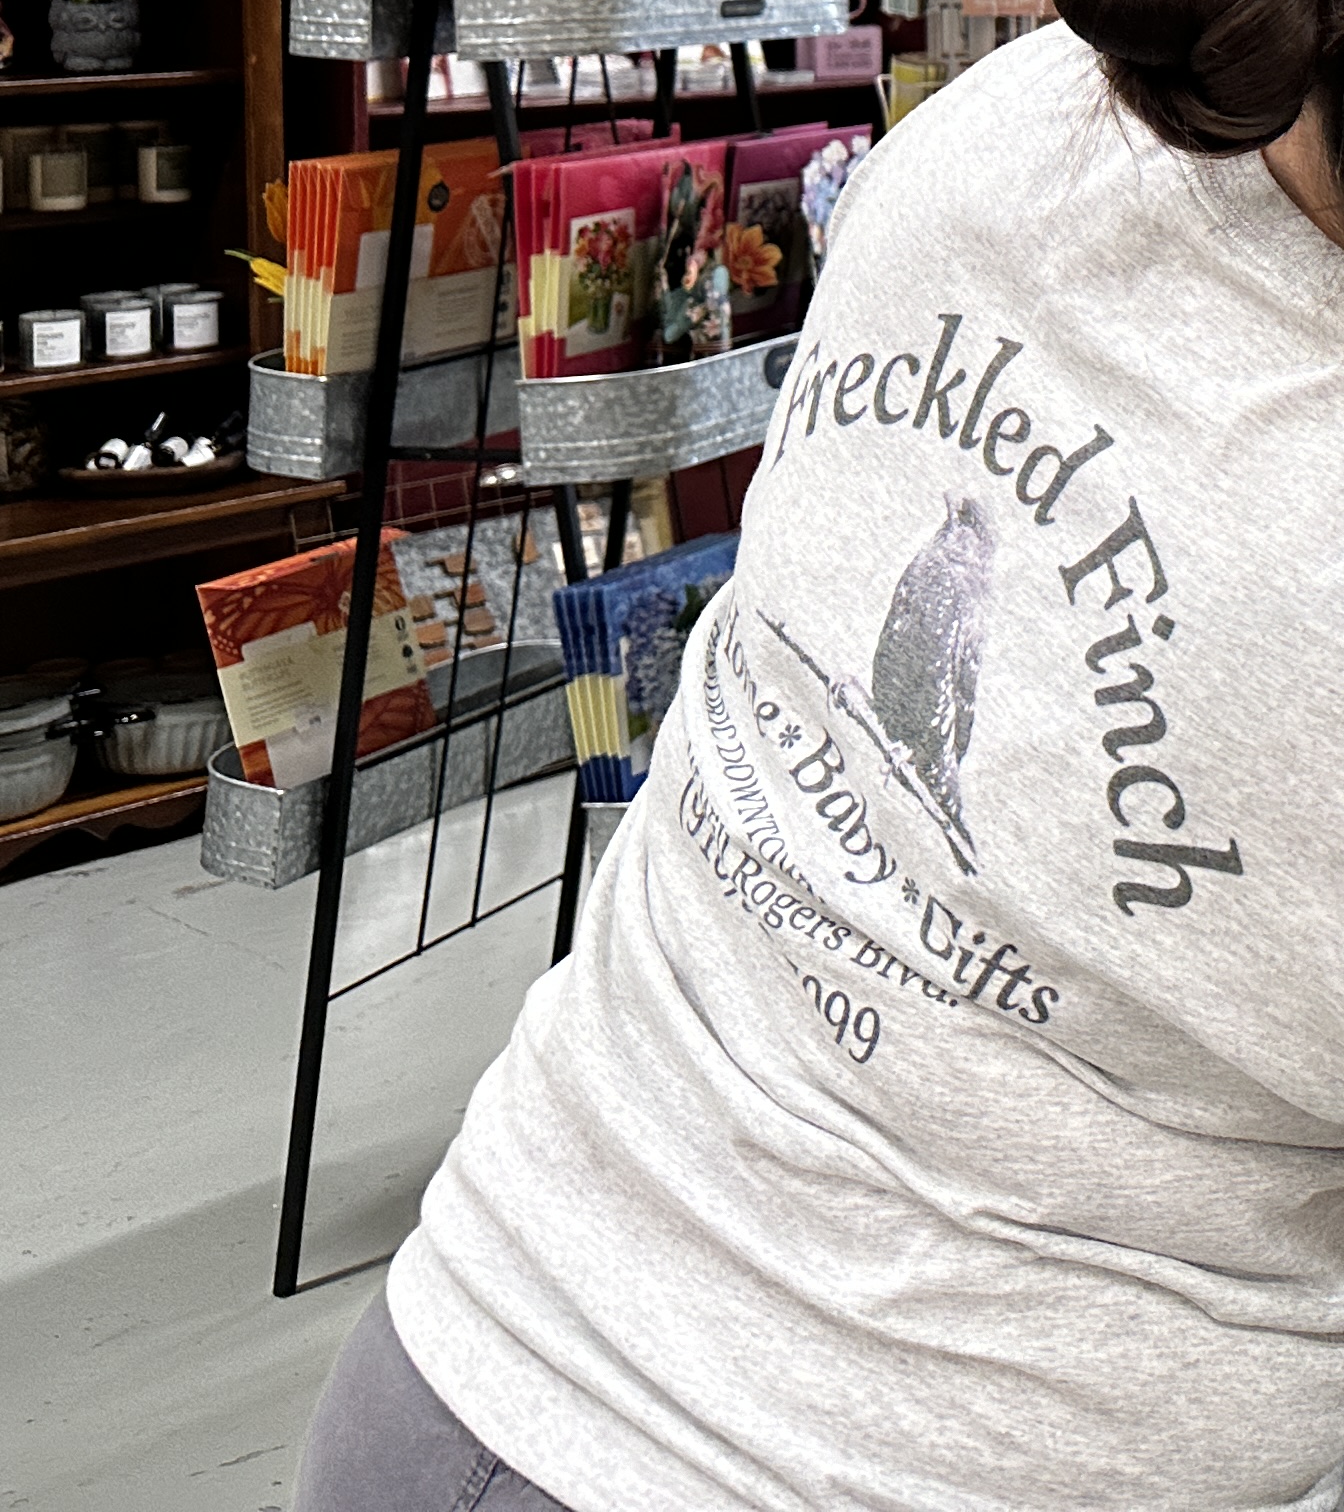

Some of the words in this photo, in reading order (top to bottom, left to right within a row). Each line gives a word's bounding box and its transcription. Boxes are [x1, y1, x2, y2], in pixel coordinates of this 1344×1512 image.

[1058, 495, 1244, 917] Finch
[731, 850, 853, 951] Rogers
[788, 726, 897, 884] Baby
[919, 893, 1060, 1025] Gifts
